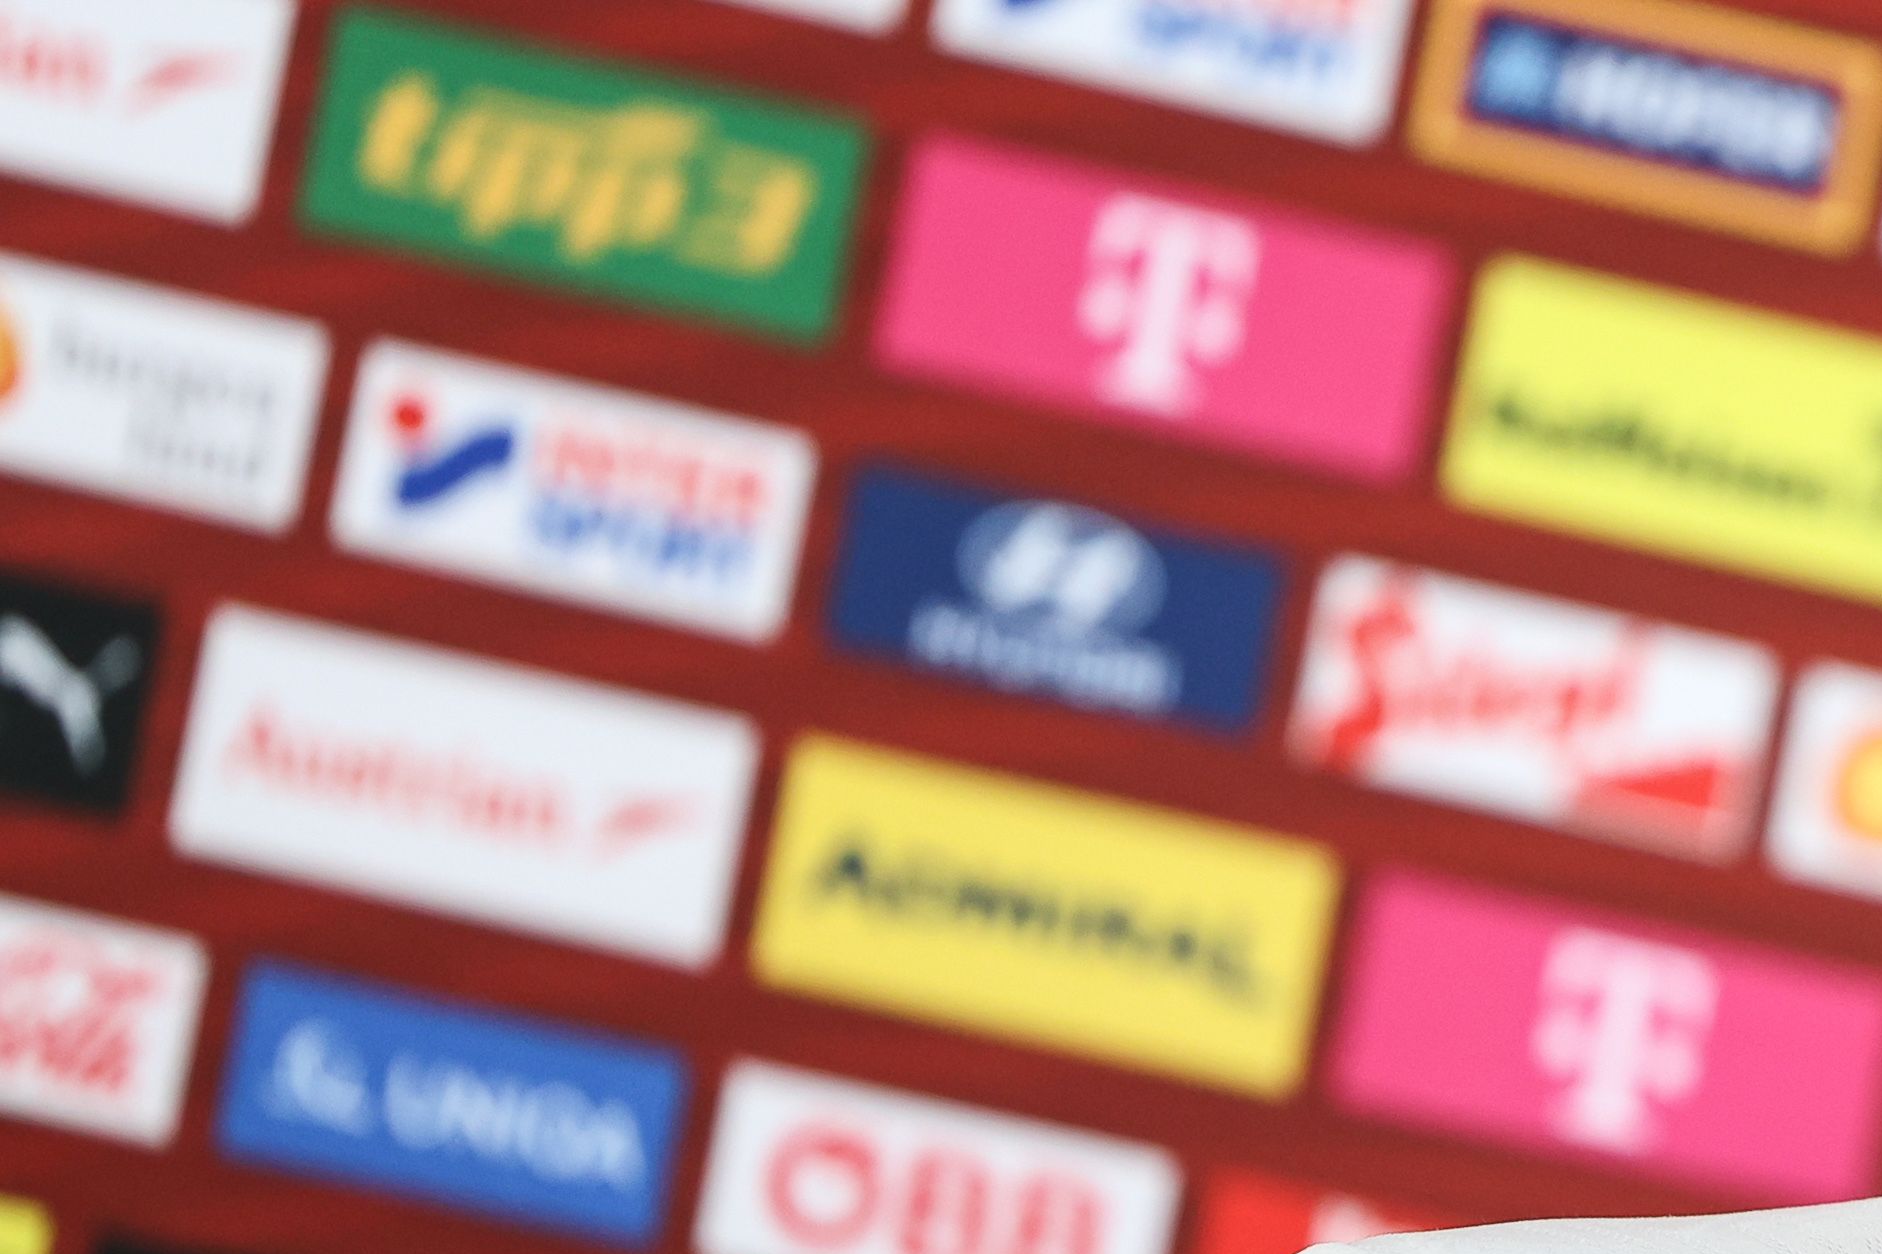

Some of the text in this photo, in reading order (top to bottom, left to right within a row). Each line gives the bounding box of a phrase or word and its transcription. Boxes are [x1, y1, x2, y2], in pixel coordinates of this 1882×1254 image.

[358, 68, 818, 278] tipp3
[810, 842, 1266, 1012] ADMIRAL
[382, 1050, 650, 1190] UNIQA
